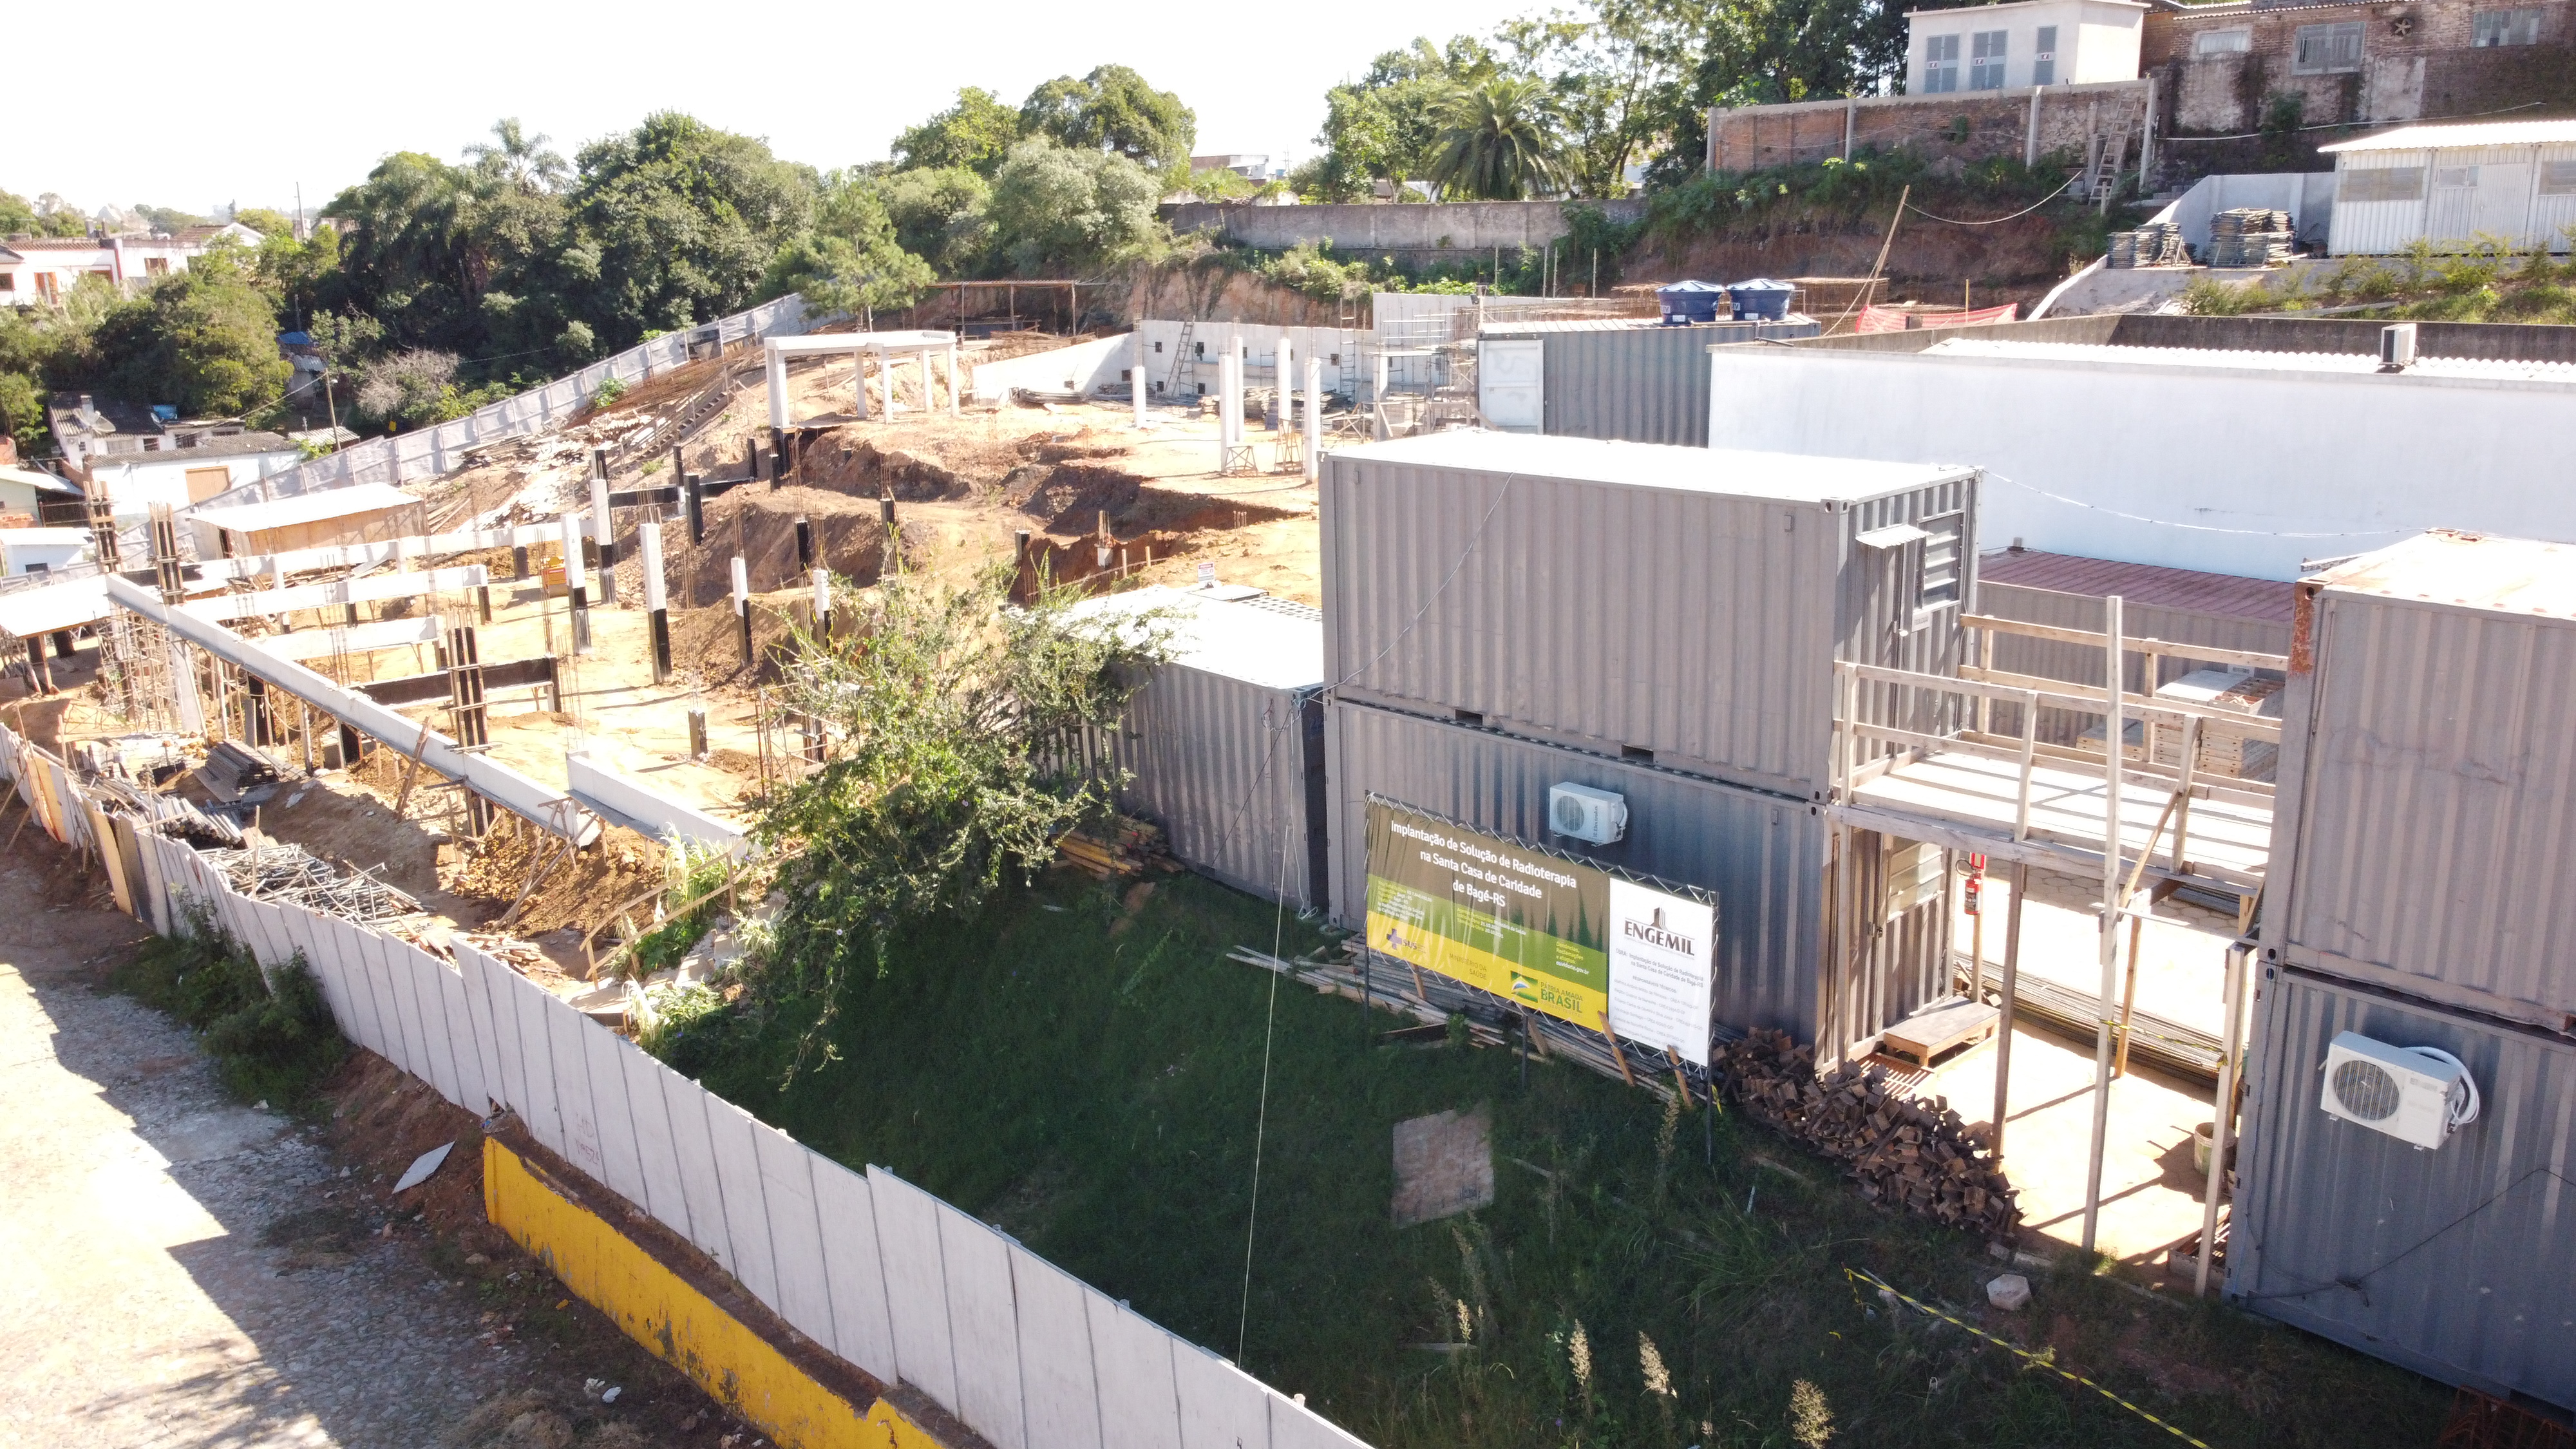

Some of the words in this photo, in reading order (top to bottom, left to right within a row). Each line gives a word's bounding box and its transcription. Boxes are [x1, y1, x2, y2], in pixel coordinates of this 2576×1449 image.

[1391, 820, 1446, 847] Implantação
[1446, 837, 1458, 851] de
[1459, 841, 1497, 863] Solução
[1499, 854, 1510, 868] de
[1512, 858, 1577, 888] Radioterapia
[1420, 851, 1431, 862] na
[1432, 853, 1459, 871] Santa
[1461, 862, 1483, 880] Casa
[1484, 869, 1497, 884] de
[1499, 875, 1542, 898] Caridade
[1452, 879, 1464, 893] de
[1466, 883, 1506, 907] Bagé-RS
[1624, 920, 1695, 956] ENGEMIL
[1449, 952, 1478, 969] MINISTÉRIO
[1469, 968, 1486, 980] SAÚDE
[1540, 981, 1560, 994] PÁTRIA
[1561, 989, 1583, 1001] AMADA
[1540, 988, 1583, 1013] BRASIL
